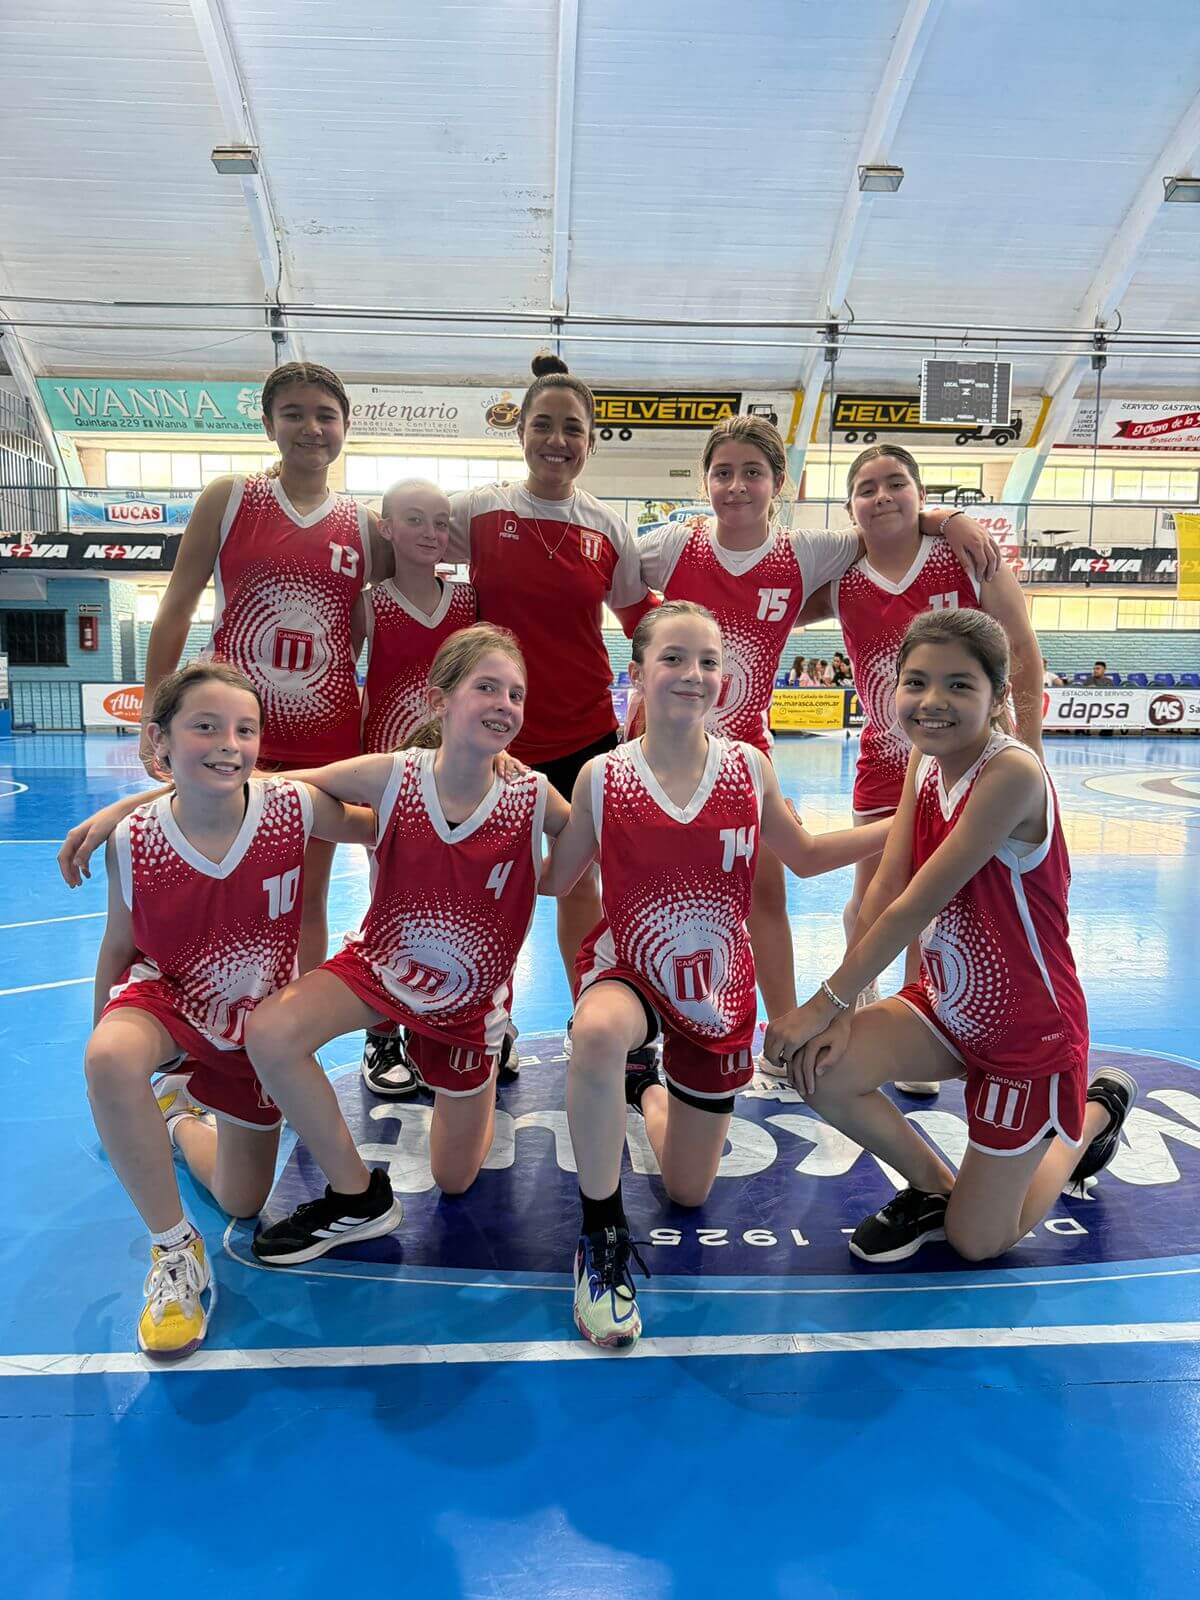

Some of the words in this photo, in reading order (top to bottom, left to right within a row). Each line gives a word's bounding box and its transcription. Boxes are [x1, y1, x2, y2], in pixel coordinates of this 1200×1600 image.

[54, 386, 226, 418] WANNA
[593, 400, 735, 420] HELVETICA
[1121, 402, 1159, 411] SERVICIO
[351, 402, 459, 422] entenario
[836, 405, 920, 423] HELVE
[75, 418, 118, 428] Quintana
[120, 418, 140, 428] 229
[155, 420, 188, 429] Wanna
[111, 506, 161, 520] LUCAS
[83, 545, 162, 560] NOVA
[328, 541, 359, 578] 13
[1071, 558, 1143, 573] NOVA
[756, 588, 792, 622] 15
[929, 591, 958, 610] 11
[1058, 698, 1130, 724] dapsa
[719, 824, 756, 873] 14
[485, 859, 515, 900] 4
[263, 865, 301, 921] 10
[985, 1073, 1028, 1091] CAMPAÑA
[648, 1228, 810, 1247] 1925
